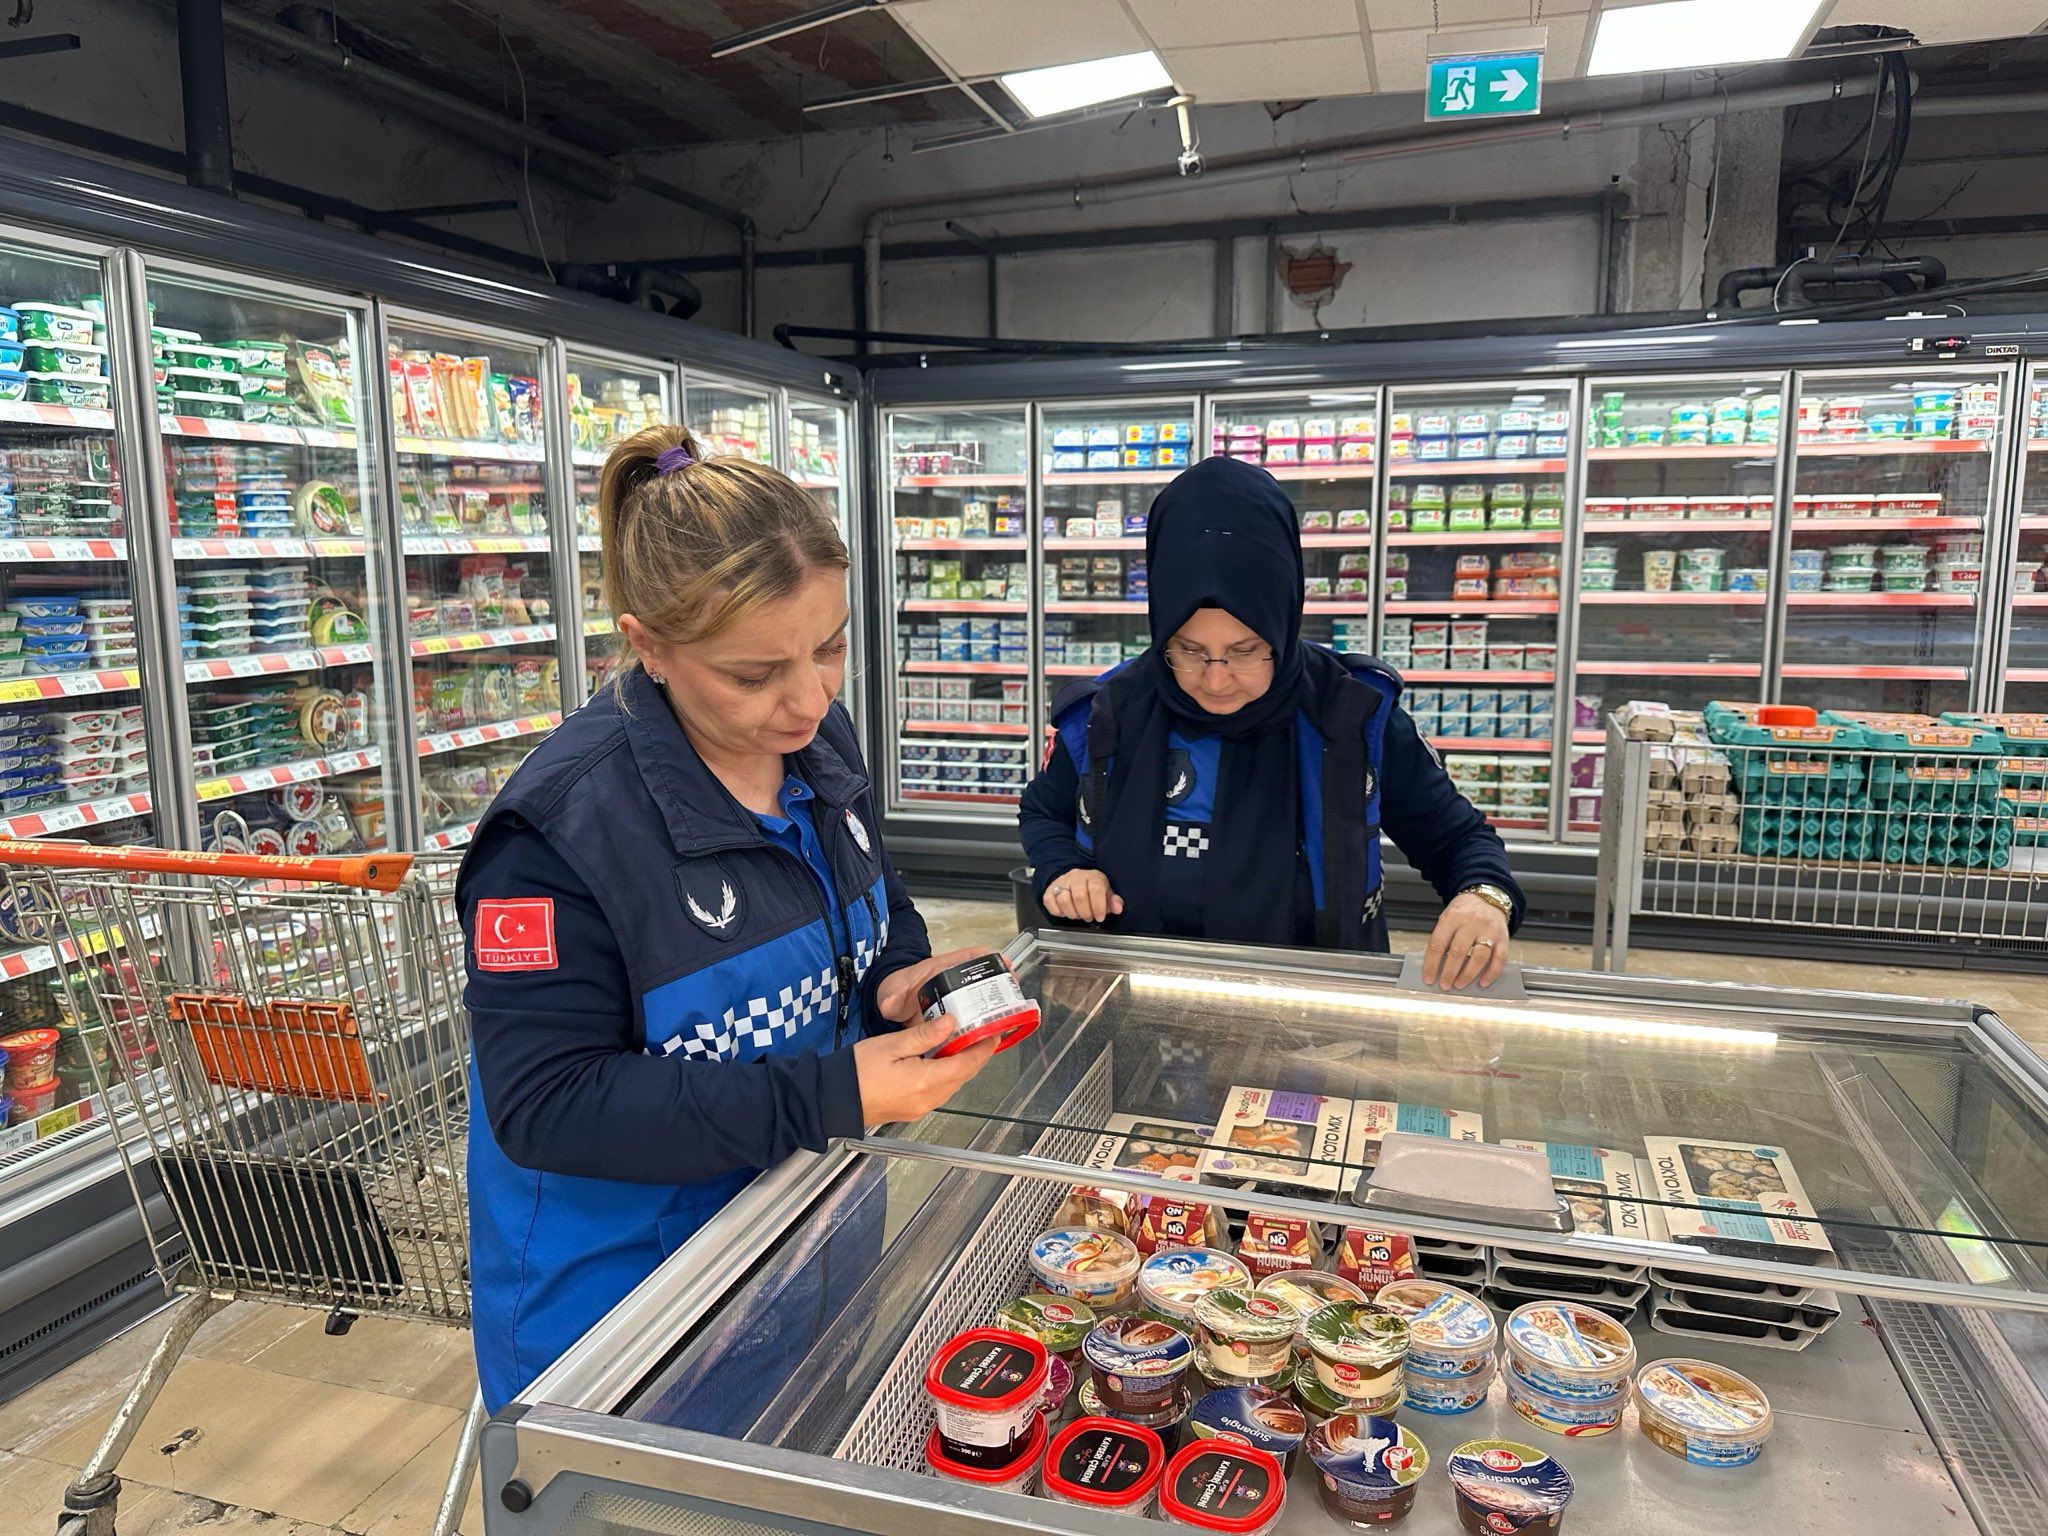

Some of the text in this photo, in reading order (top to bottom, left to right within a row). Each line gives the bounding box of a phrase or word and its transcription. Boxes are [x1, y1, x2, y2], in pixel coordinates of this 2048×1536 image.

[485, 952, 542, 962] TÜRKİYE
[1657, 1156, 1680, 1188] TOKYO
[1615, 1171, 1633, 1192] MIX
[1220, 1416, 1272, 1442] Supangle
[1491, 1456, 1519, 1466] eker
[1477, 1472, 1540, 1485] Supangle
